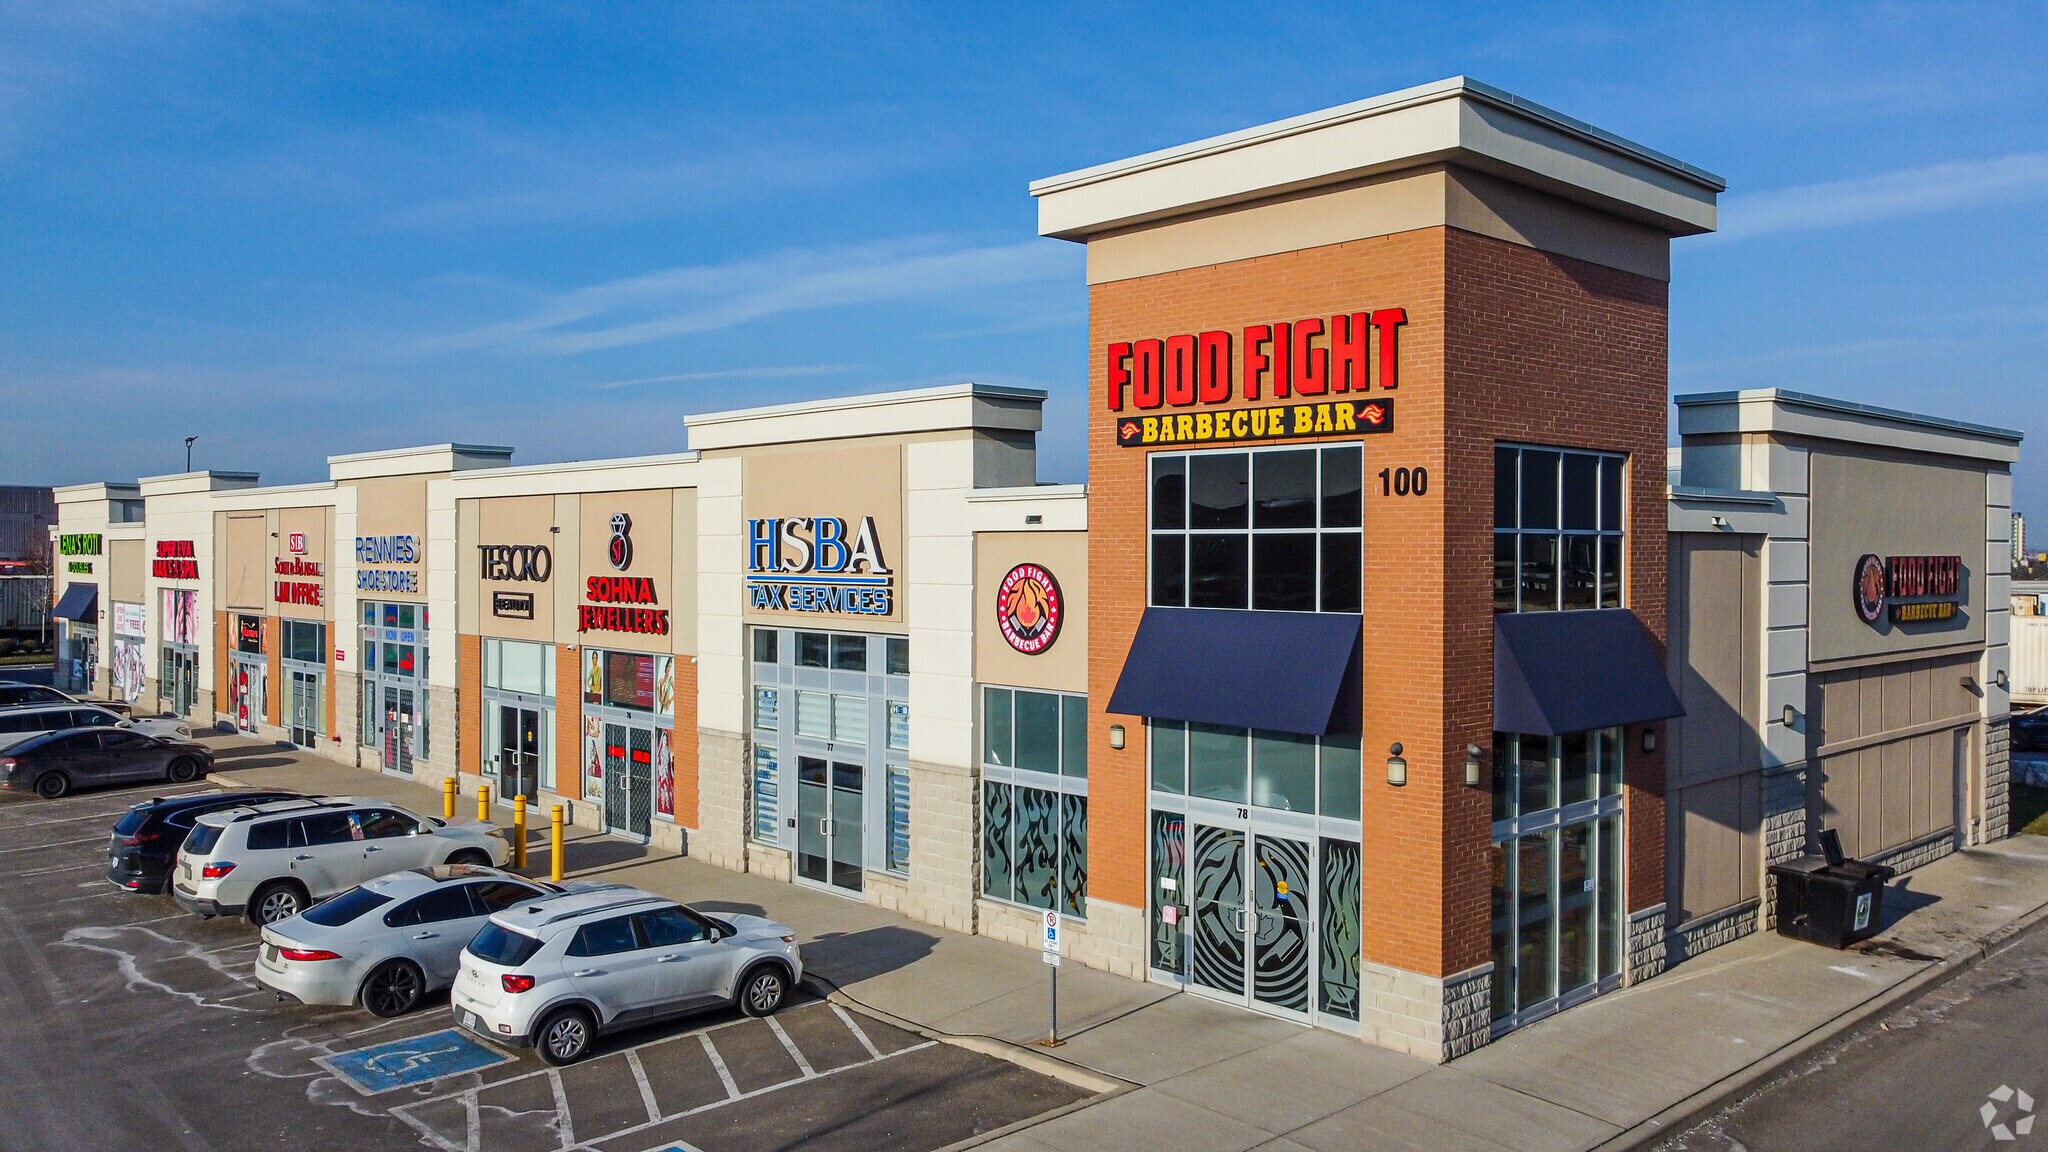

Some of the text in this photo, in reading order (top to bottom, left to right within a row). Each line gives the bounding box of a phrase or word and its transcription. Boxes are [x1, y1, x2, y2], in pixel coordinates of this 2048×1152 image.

[1108, 308, 1408, 411] FOOD FIGHT
[1142, 402, 1356, 443] BARBECUE BAR
[1378, 467, 1427, 496] 100
[82, 533, 101, 555] ROTI
[156, 541, 194, 557] SUPER EVA
[356, 535, 418, 563] RENNIES
[748, 516, 890, 572] HSBA
[153, 560, 198, 579] NAILS & SPA
[477, 545, 552, 582] TESORO
[1892, 556, 1961, 596] FOOD FIGHT
[357, 570, 415, 591] SHOE STORE
[587, 576, 654, 604] SOHNA
[1003, 567, 1053, 593] FOOD FIGHT
[275, 581, 320, 606] LAW OFFICE
[495, 598, 530, 611] BEAUTY
[747, 585, 891, 615] TAX SERVICES
[130, 619, 139, 630] FREE
[577, 605, 666, 635] JEWELLERS
[1902, 602, 1952, 621] BARBECUE BAR
[386, 630, 414, 642] NOW OPEN
[1001, 621, 1054, 651] BARBECUE BAR
[827, 743, 834, 751] 77
[1237, 808, 1248, 819] 78
